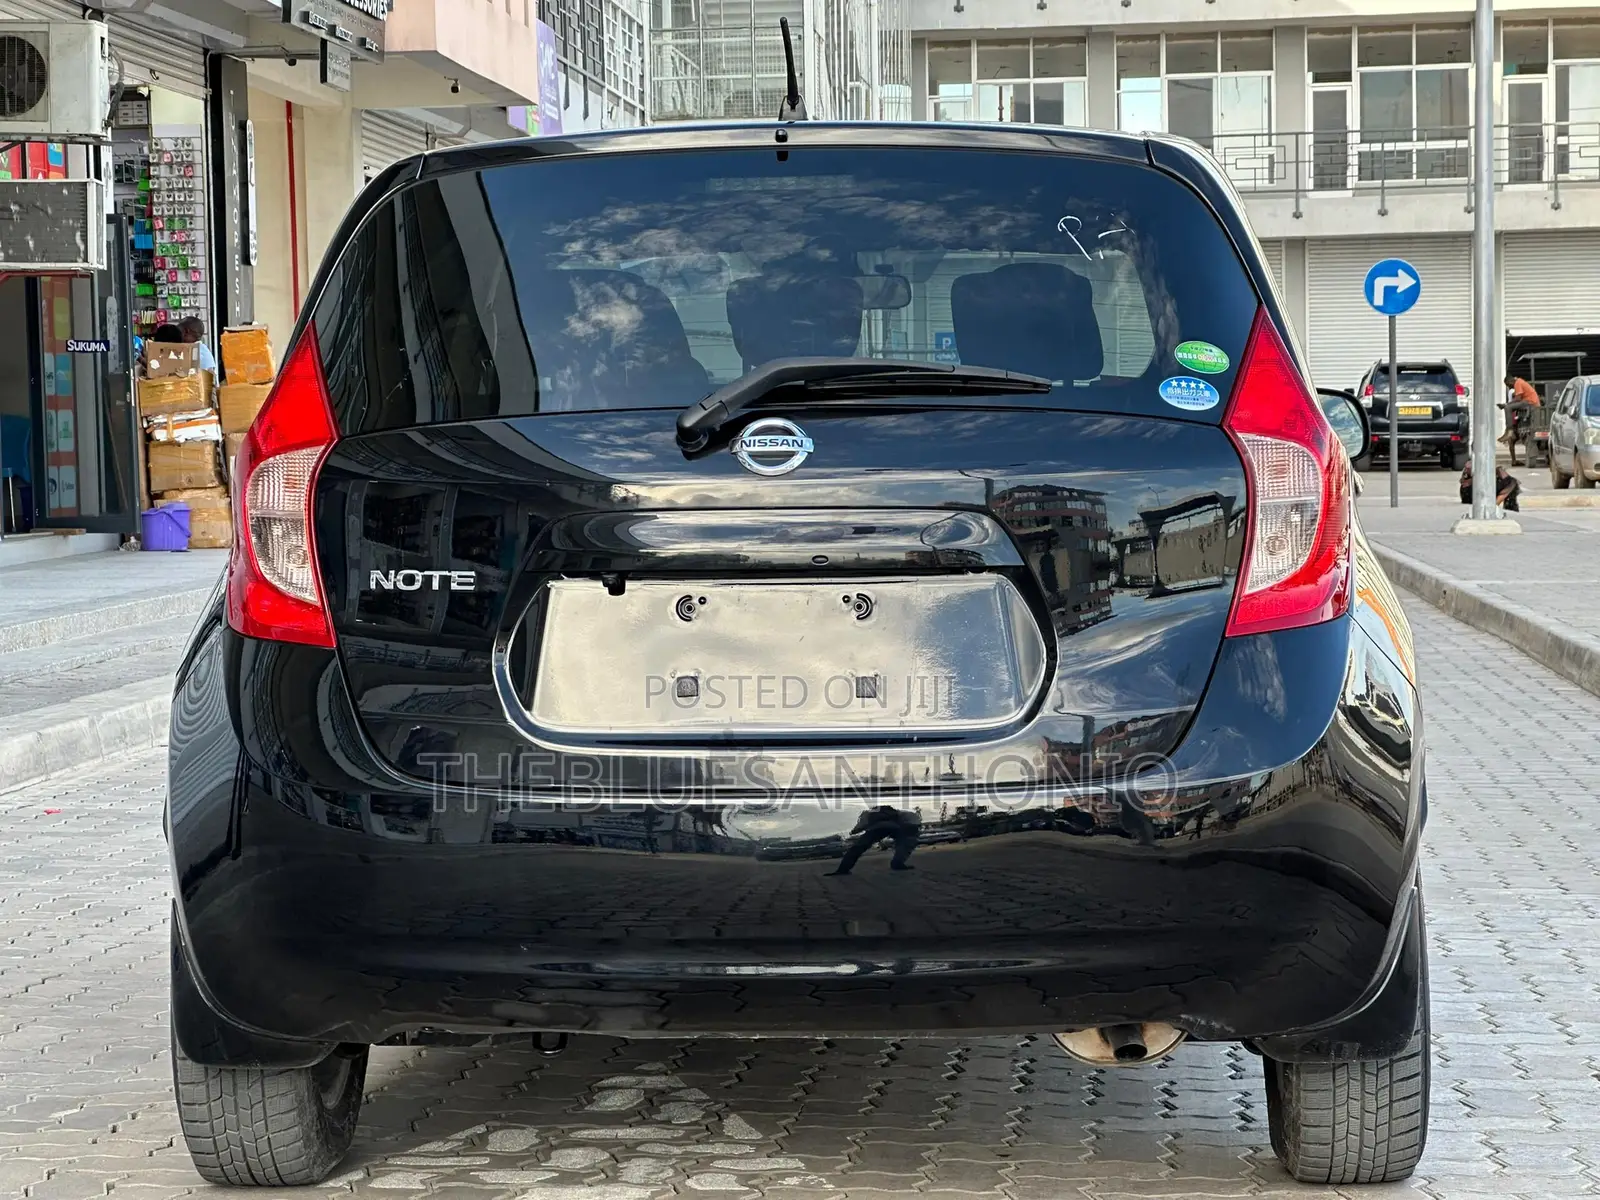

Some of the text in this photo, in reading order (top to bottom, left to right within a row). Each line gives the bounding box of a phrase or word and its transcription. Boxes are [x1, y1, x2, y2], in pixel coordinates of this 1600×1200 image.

[67, 339, 107, 352] SUKUMA
[740, 438, 804, 448] NISSAN
[370, 569, 476, 591] NOTE
